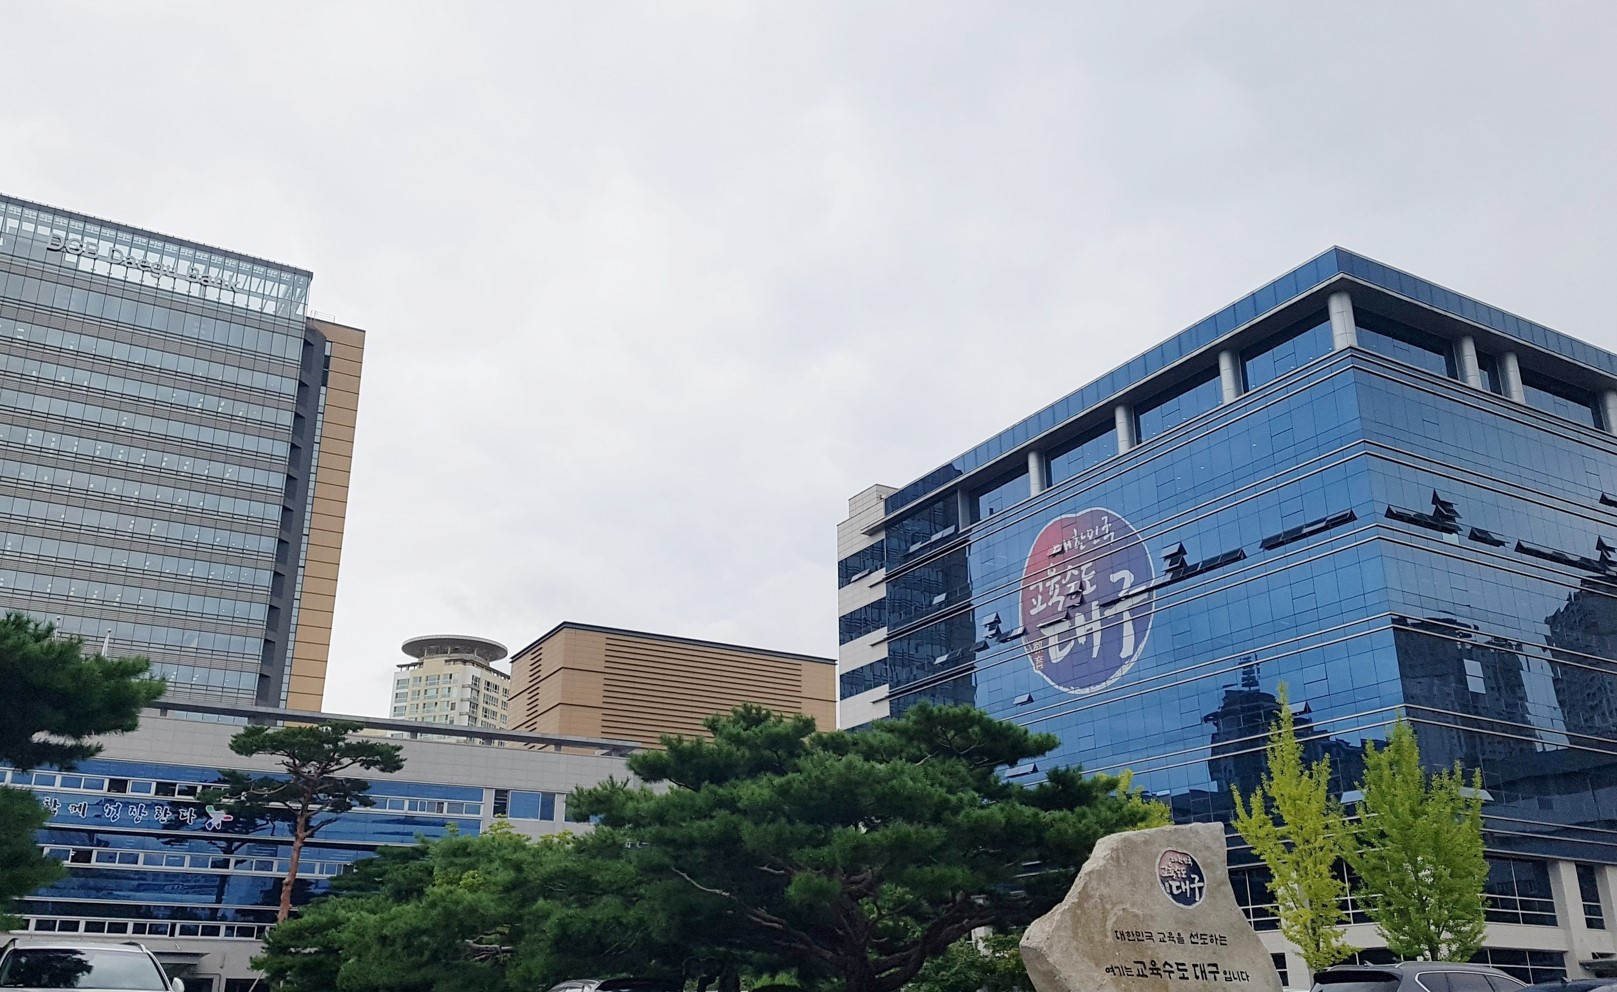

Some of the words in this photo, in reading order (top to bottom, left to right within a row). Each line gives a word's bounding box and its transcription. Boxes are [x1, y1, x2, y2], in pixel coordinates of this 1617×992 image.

[47, 233, 99, 259] DGB
[107, 247, 179, 278] Daegu
[187, 266, 241, 293] Bank
[1048, 515, 1115, 557] 대한민국
[1029, 561, 1097, 616] 교육수도
[1039, 569, 1149, 664] 대구
[1168, 874, 1205, 902] 대구
[1114, 930, 1155, 943] 대한민국
[1157, 931, 1185, 945] 교육을
[1189, 932, 1228, 946] 선도하는
[1133, 960, 1190, 981] 교육수도
[1191, 962, 1220, 982] 대구
